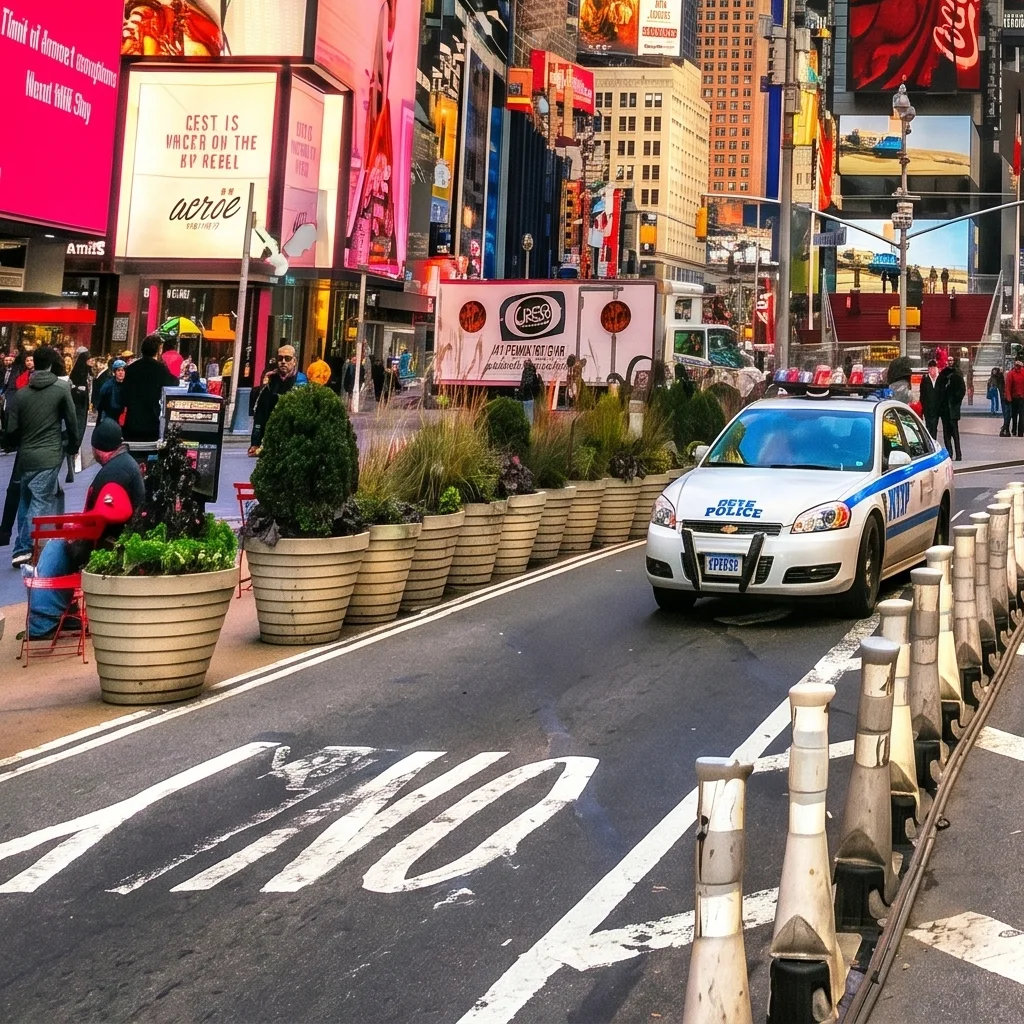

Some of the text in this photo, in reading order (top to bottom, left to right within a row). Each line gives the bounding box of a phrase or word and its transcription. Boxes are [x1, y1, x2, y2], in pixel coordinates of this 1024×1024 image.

[225, 114, 239, 132] IS
[234, 135, 258, 151] THE
[704, 506, 764, 519] POLICE
